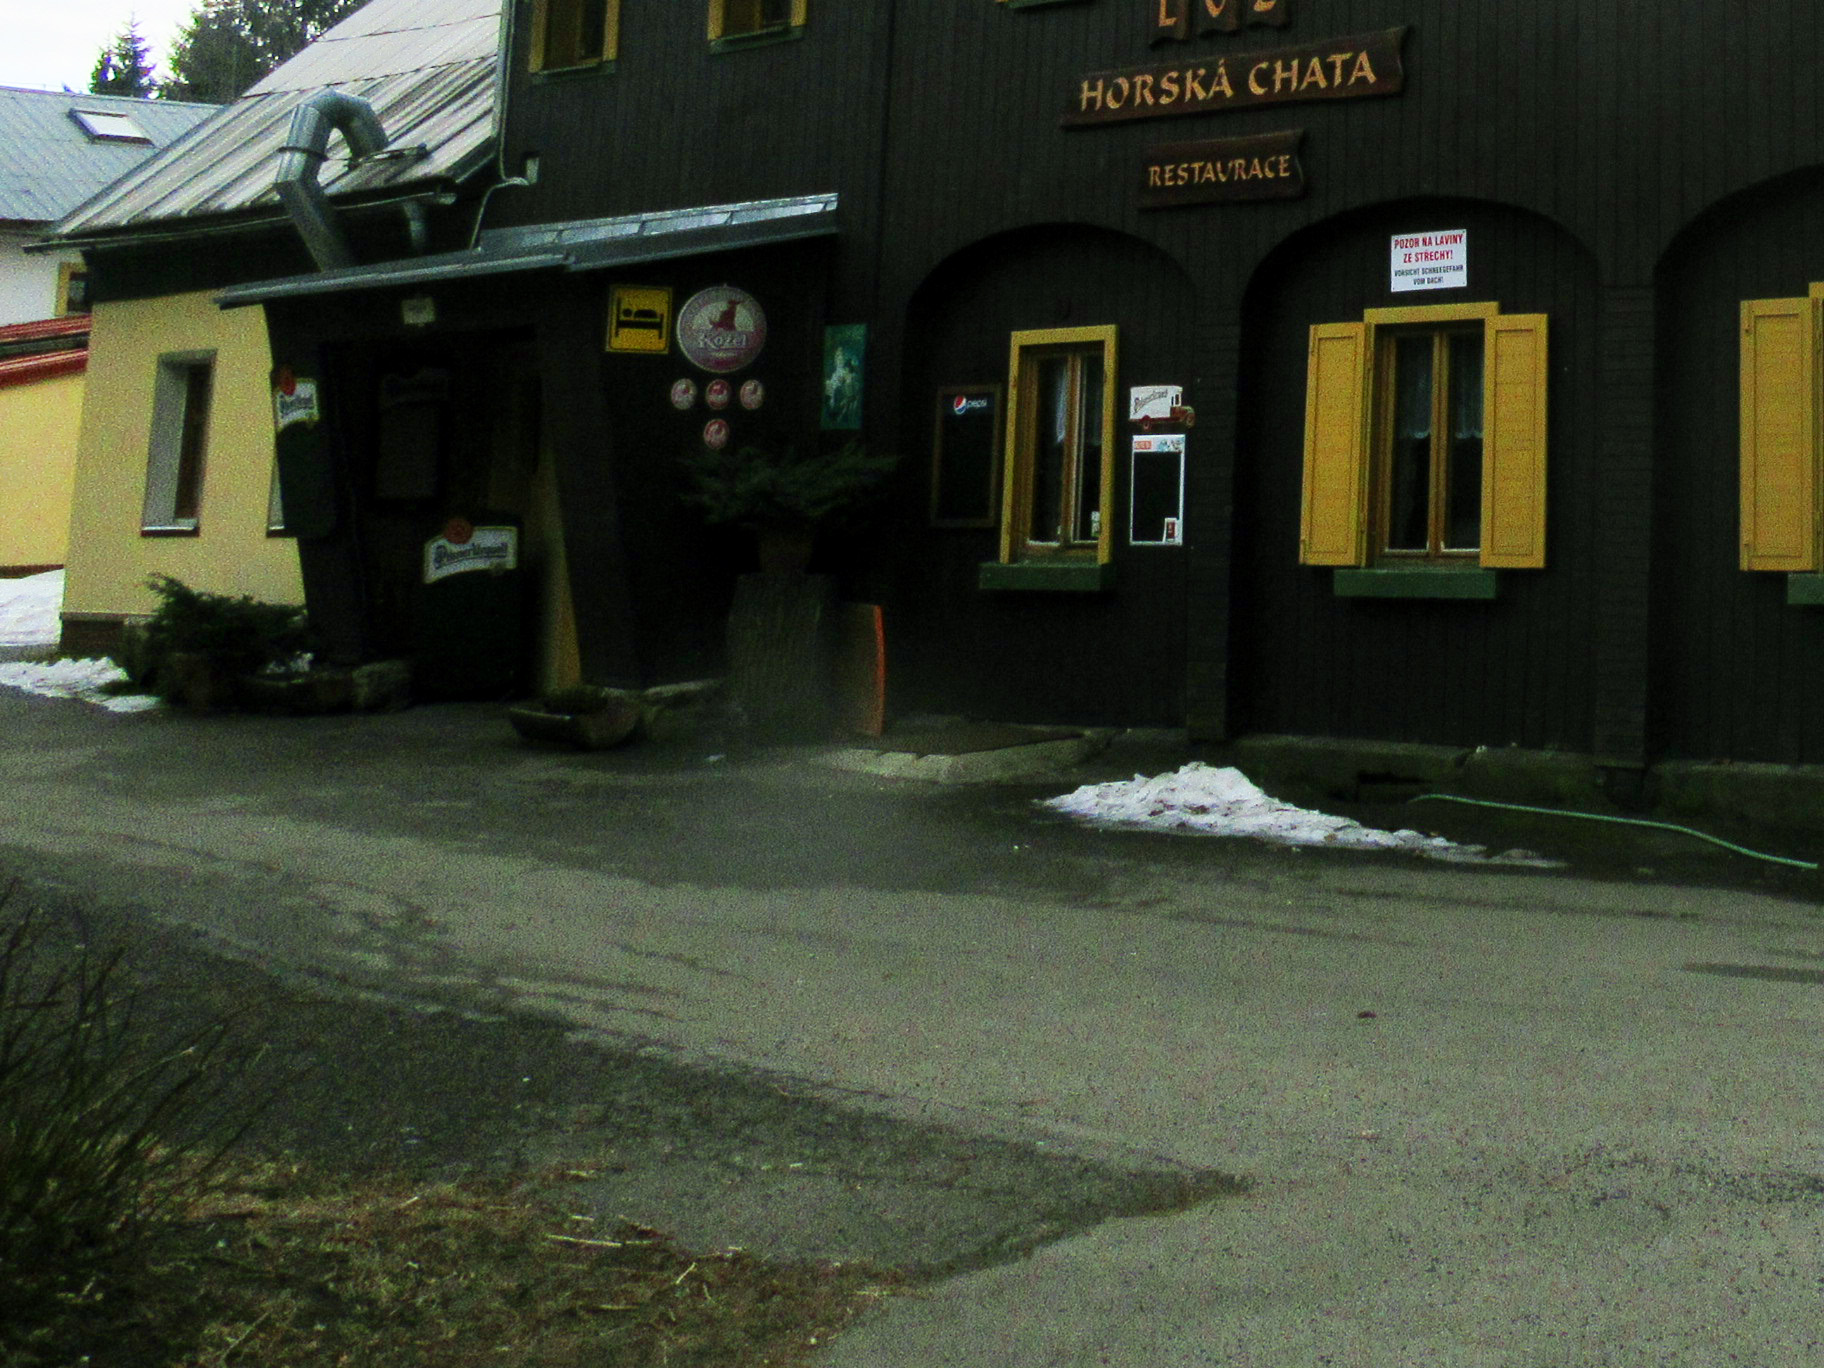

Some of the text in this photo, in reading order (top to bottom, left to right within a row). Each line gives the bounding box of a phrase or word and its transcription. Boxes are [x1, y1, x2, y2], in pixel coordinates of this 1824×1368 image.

[1079, 49, 1377, 111] HORSKÁ CHATA
[1148, 154, 1290, 187] RESTAURACE
[1394, 234, 1463, 249] POZOR NA LAVINY
[1404, 253, 1412, 263] ZE
